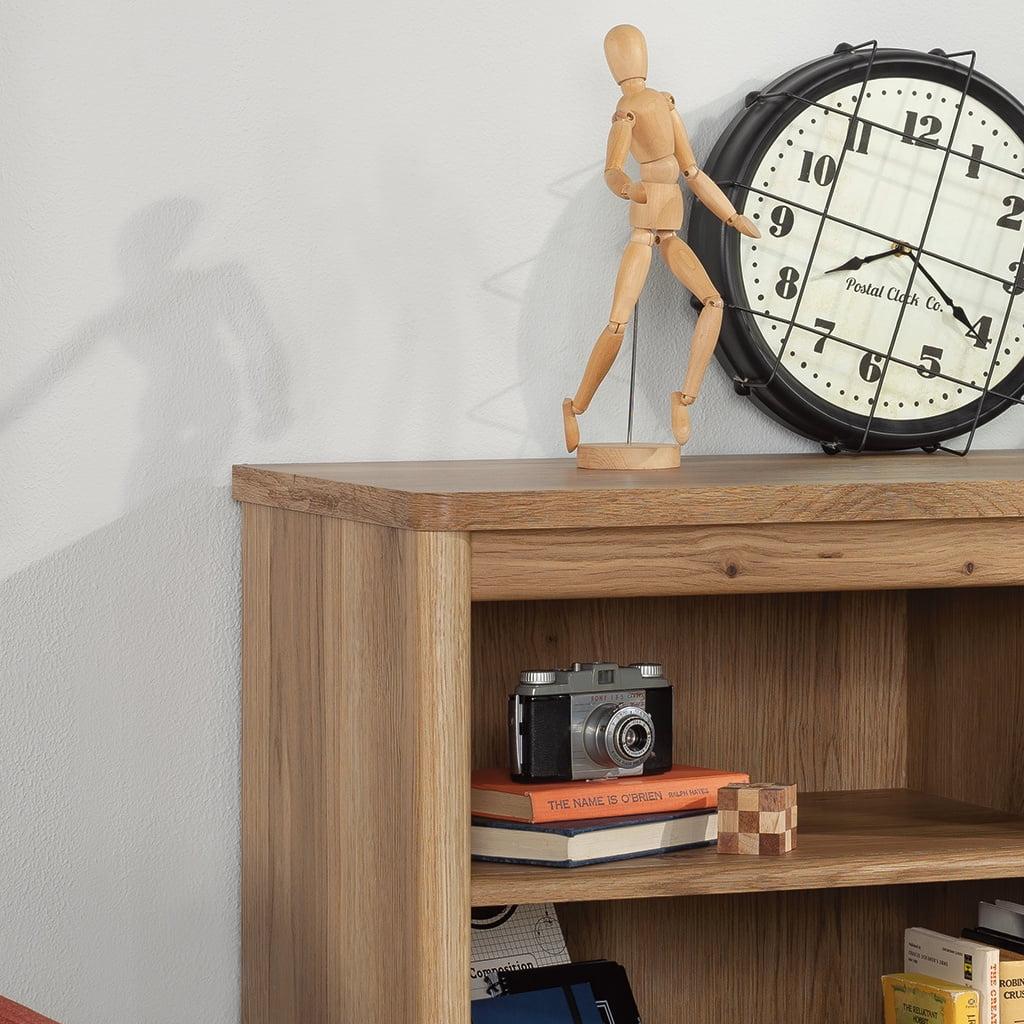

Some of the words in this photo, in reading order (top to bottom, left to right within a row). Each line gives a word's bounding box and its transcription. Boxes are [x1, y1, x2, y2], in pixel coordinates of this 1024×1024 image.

[900, 111, 943, 150] 12
[798, 150, 837, 187] 10
[965, 144, 984, 179] 1
[770, 205, 795, 238] 9
[775, 266, 798, 300] 8
[846, 277, 885, 298] Postal
[887, 287, 920, 306] Clock
[926, 296, 943, 313] Co.
[813, 318, 836, 353] 7
[964, 316, 993, 350] 4
[859, 352, 882, 383] 6
[916, 345, 943, 379] 5
[548, 800, 570, 810] THE
[573, 797, 605, 808] NAME
[607, 795, 618, 805] IS
[621, 791, 663, 804] O'BRIEN
